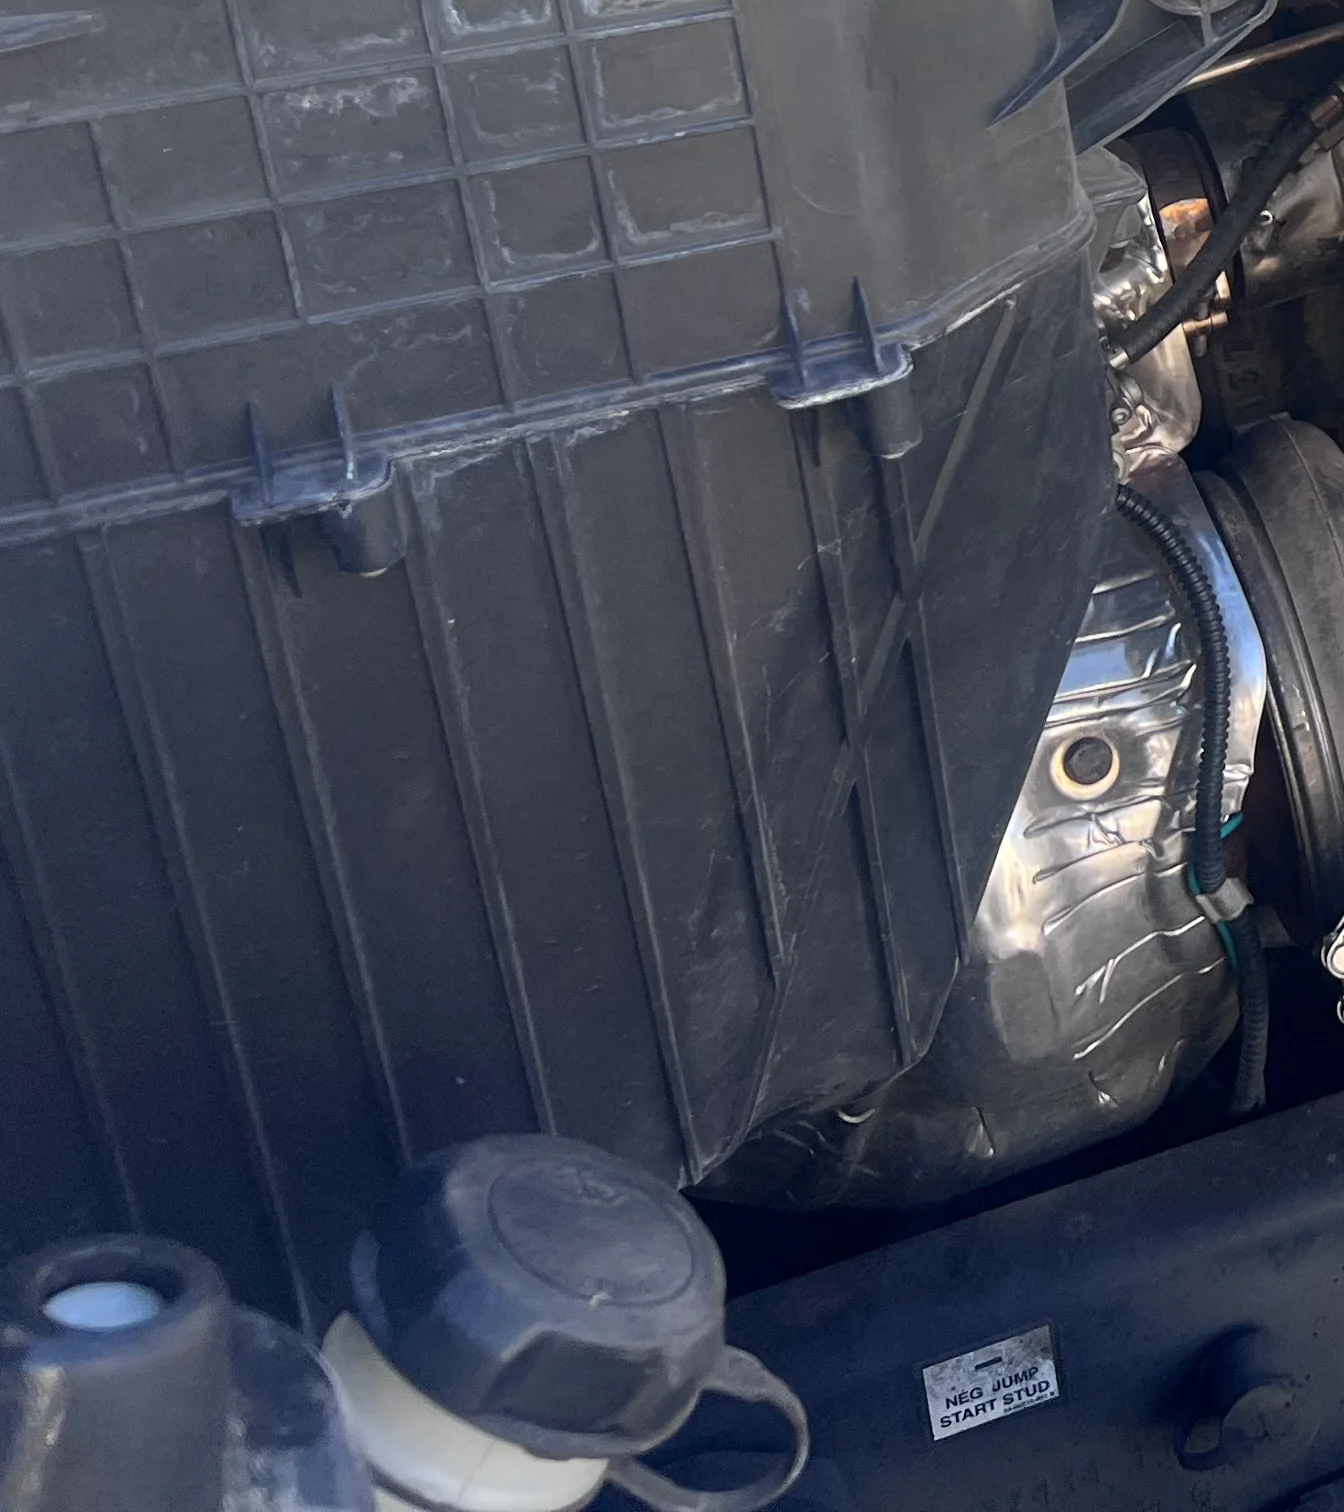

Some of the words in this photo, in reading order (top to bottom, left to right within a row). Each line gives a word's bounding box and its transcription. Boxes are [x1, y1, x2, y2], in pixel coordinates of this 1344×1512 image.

[940, 1398, 997, 1428] START
[1002, 1380, 1050, 1405] STUD
[945, 1387, 984, 1409] NEG
[992, 1367, 1039, 1392] JUMP
